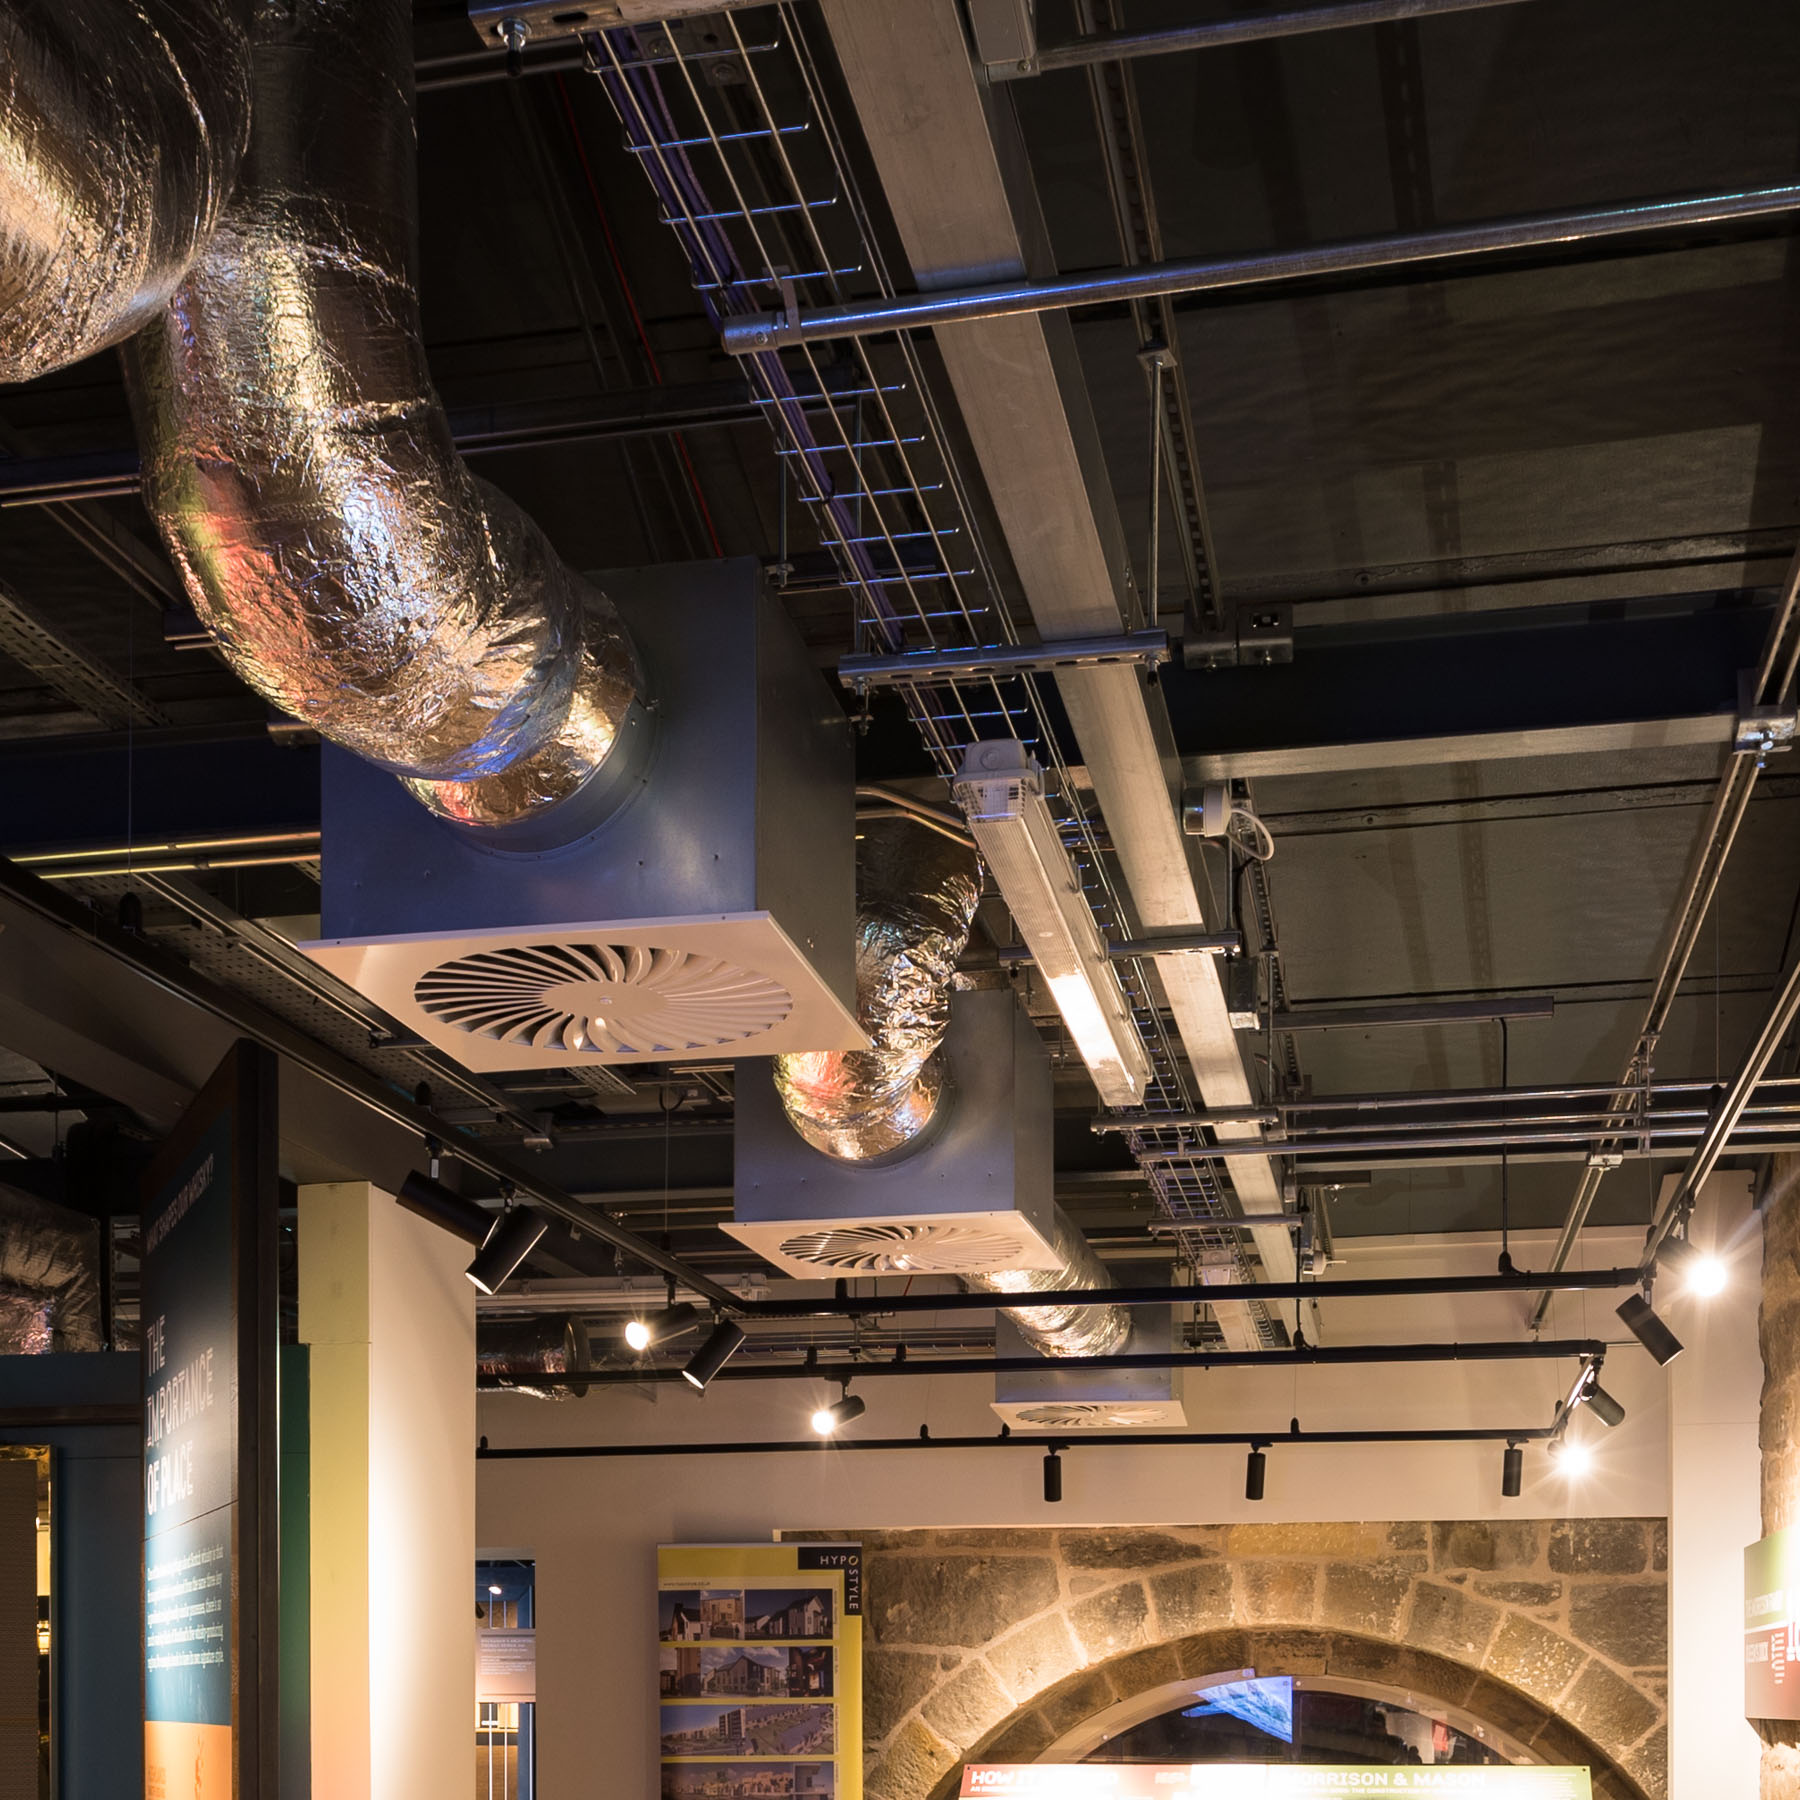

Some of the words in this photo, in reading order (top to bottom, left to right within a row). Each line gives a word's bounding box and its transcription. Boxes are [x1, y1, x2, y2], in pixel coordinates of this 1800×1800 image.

[147, 1314, 166, 1377] THE
[147, 1347, 214, 1448] IMPORTANCE
[147, 1460, 160, 1516] OF
[160, 1439, 193, 1511] PLACE
[971, 1770, 1014, 1785] HOW
[1392, 1773, 1408, 1786] &
[1413, 1773, 1487, 1787] MASON
